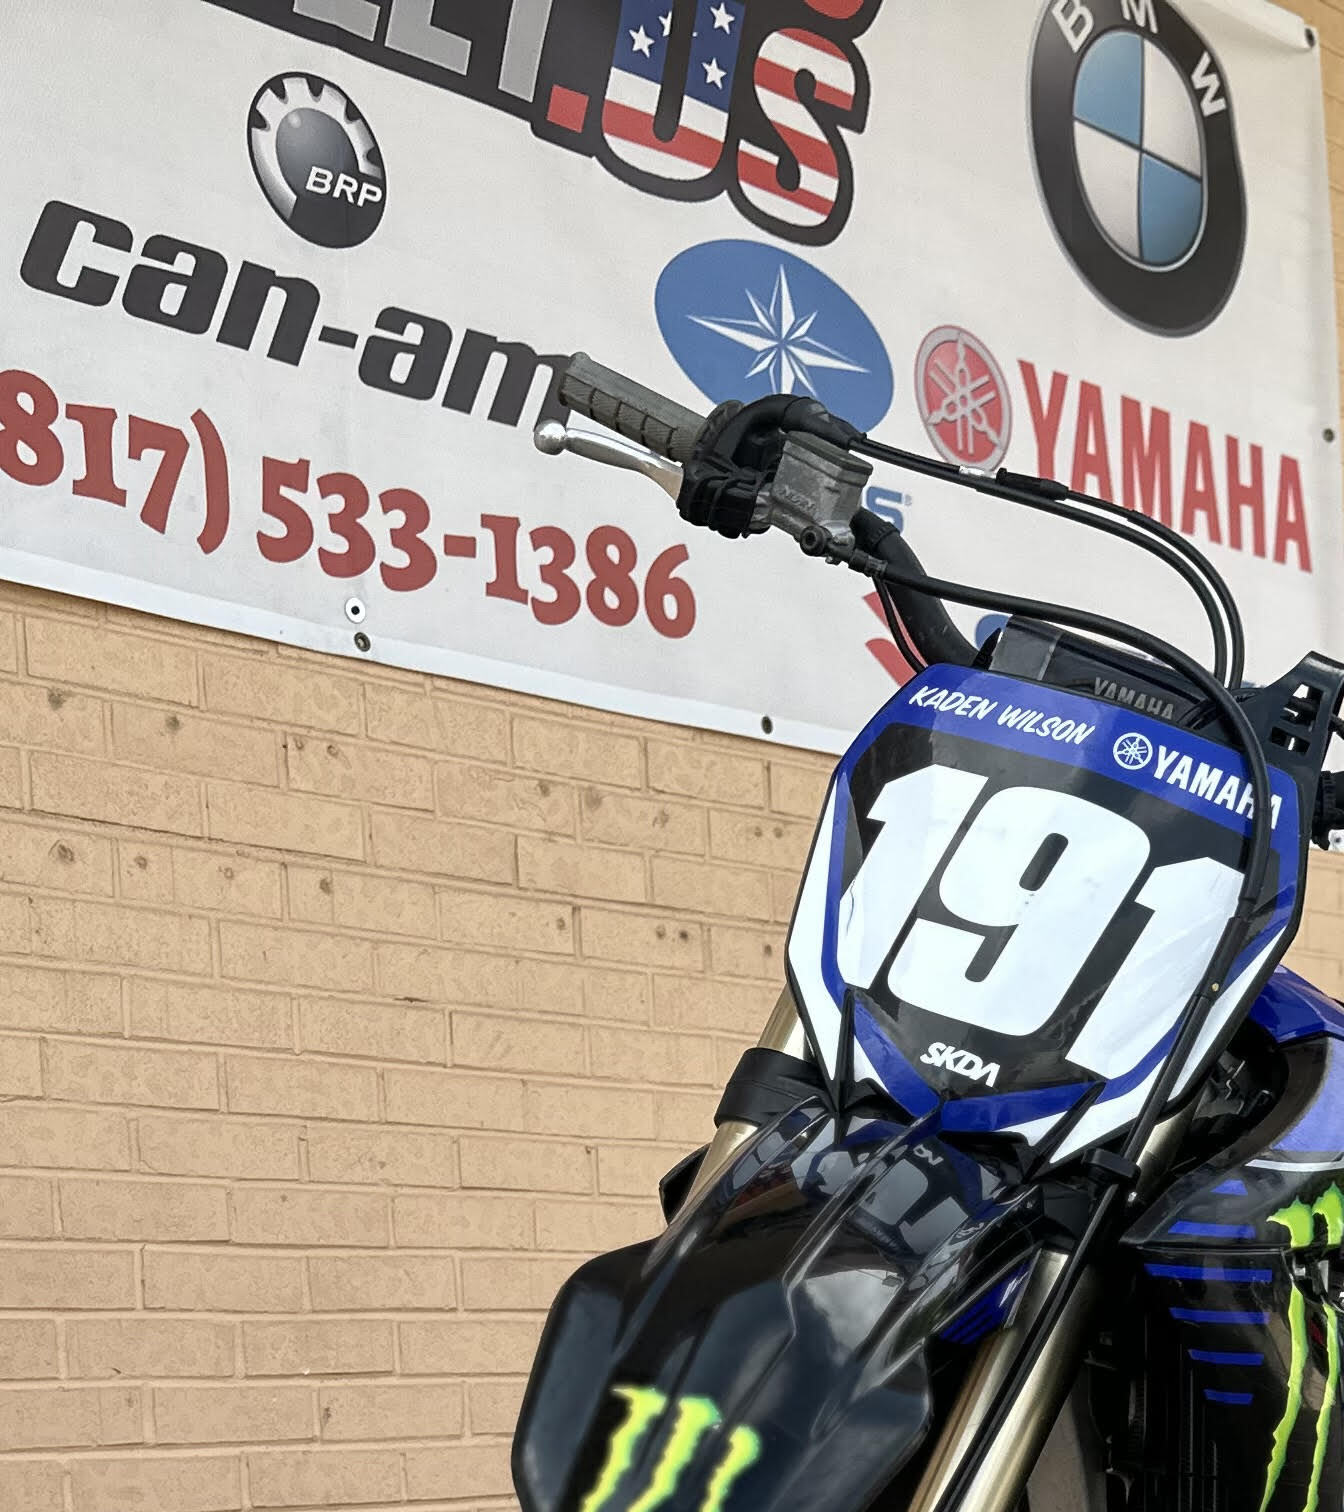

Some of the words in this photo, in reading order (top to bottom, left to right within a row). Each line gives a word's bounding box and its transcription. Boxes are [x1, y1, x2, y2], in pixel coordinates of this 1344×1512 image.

[1051, 0, 1227, 117] BMW
[305, 165, 383, 208] BRP
[20, 199, 571, 431] can-am
[1017, 358, 1313, 574] YAMAHA
[257, 457, 697, 639] 533-1386
[908, 685, 993, 721] KADEN
[998, 703, 1096, 746] WILSON
[1094, 676, 1175, 720] YAMAHA
[836, 763, 1246, 1081] 191
[919, 1041, 1001, 1088] SKDA
